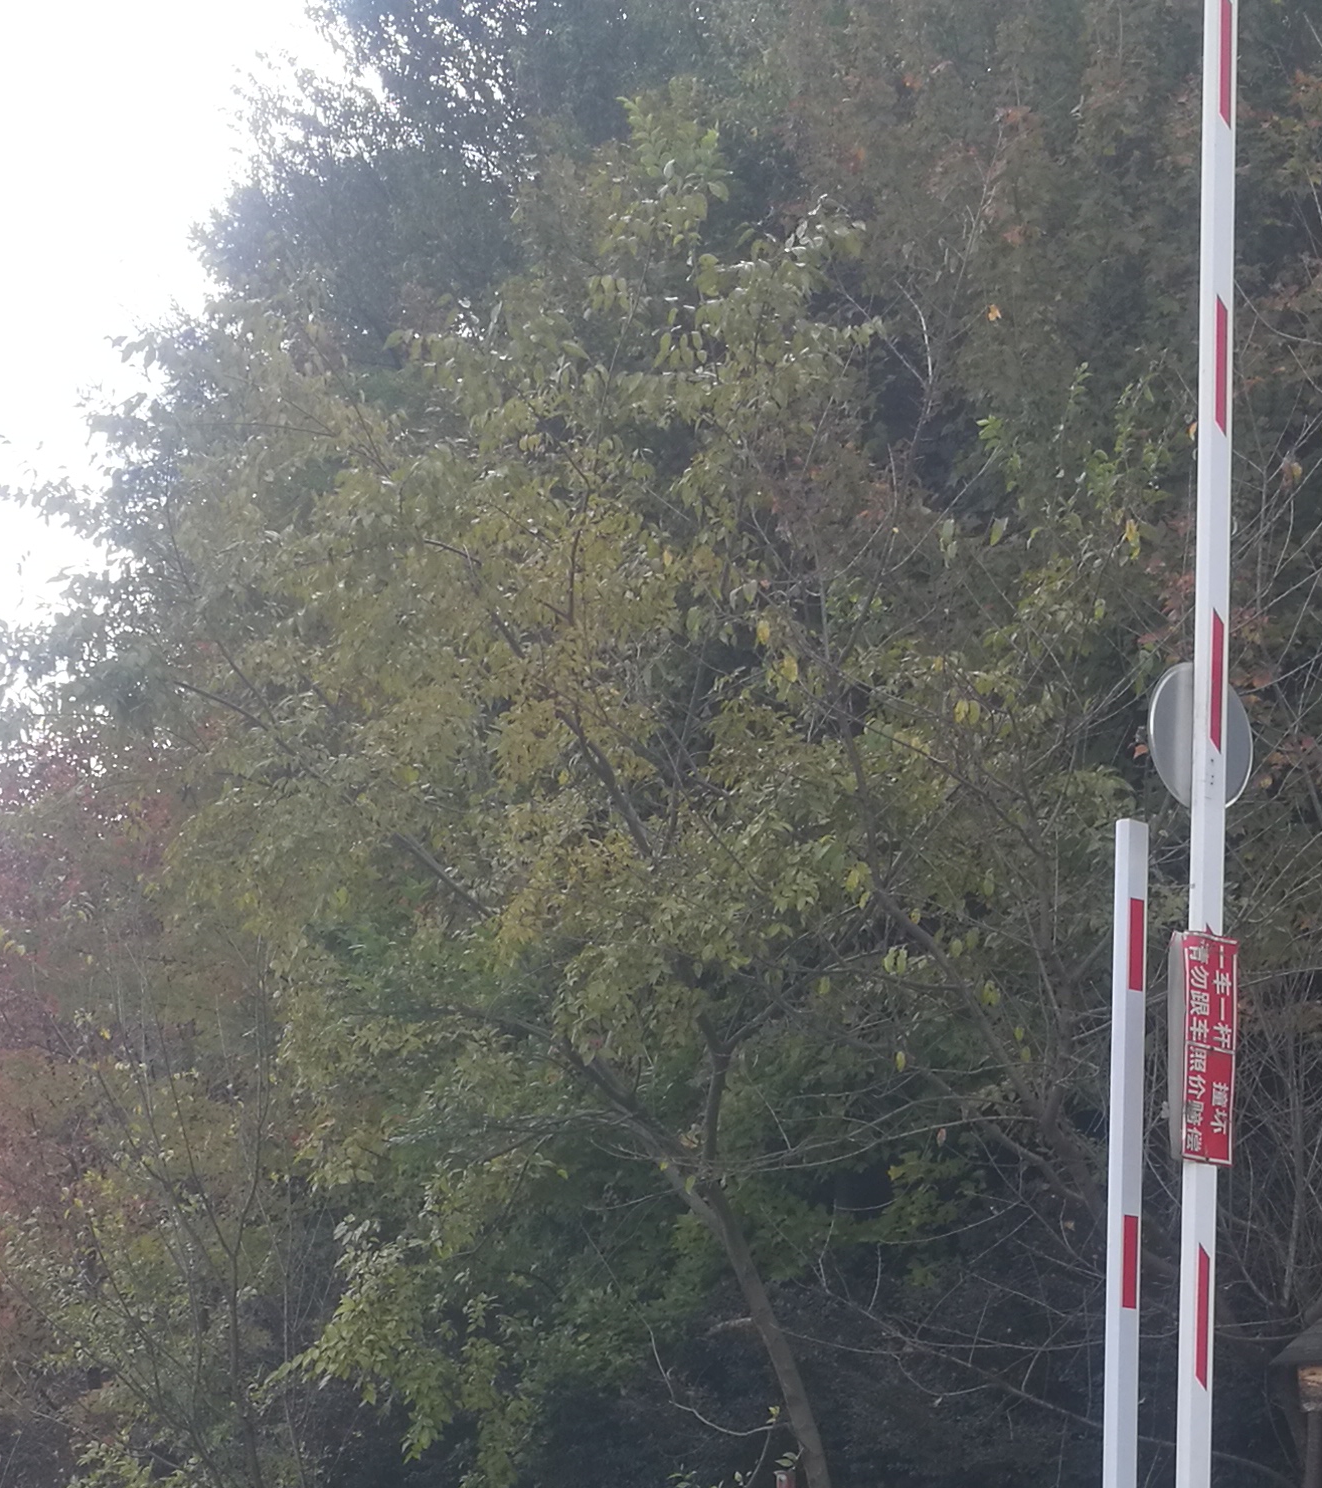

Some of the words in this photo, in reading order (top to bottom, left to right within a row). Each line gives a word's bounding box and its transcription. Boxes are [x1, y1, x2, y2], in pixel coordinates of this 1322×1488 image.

[1188, 940, 1210, 1043] 请勿跟车
[1211, 944, 1231, 1048] 一车一杆
[1186, 1045, 1207, 1152] 照价赔偿
[1210, 1081, 1229, 1134] 撞坏
